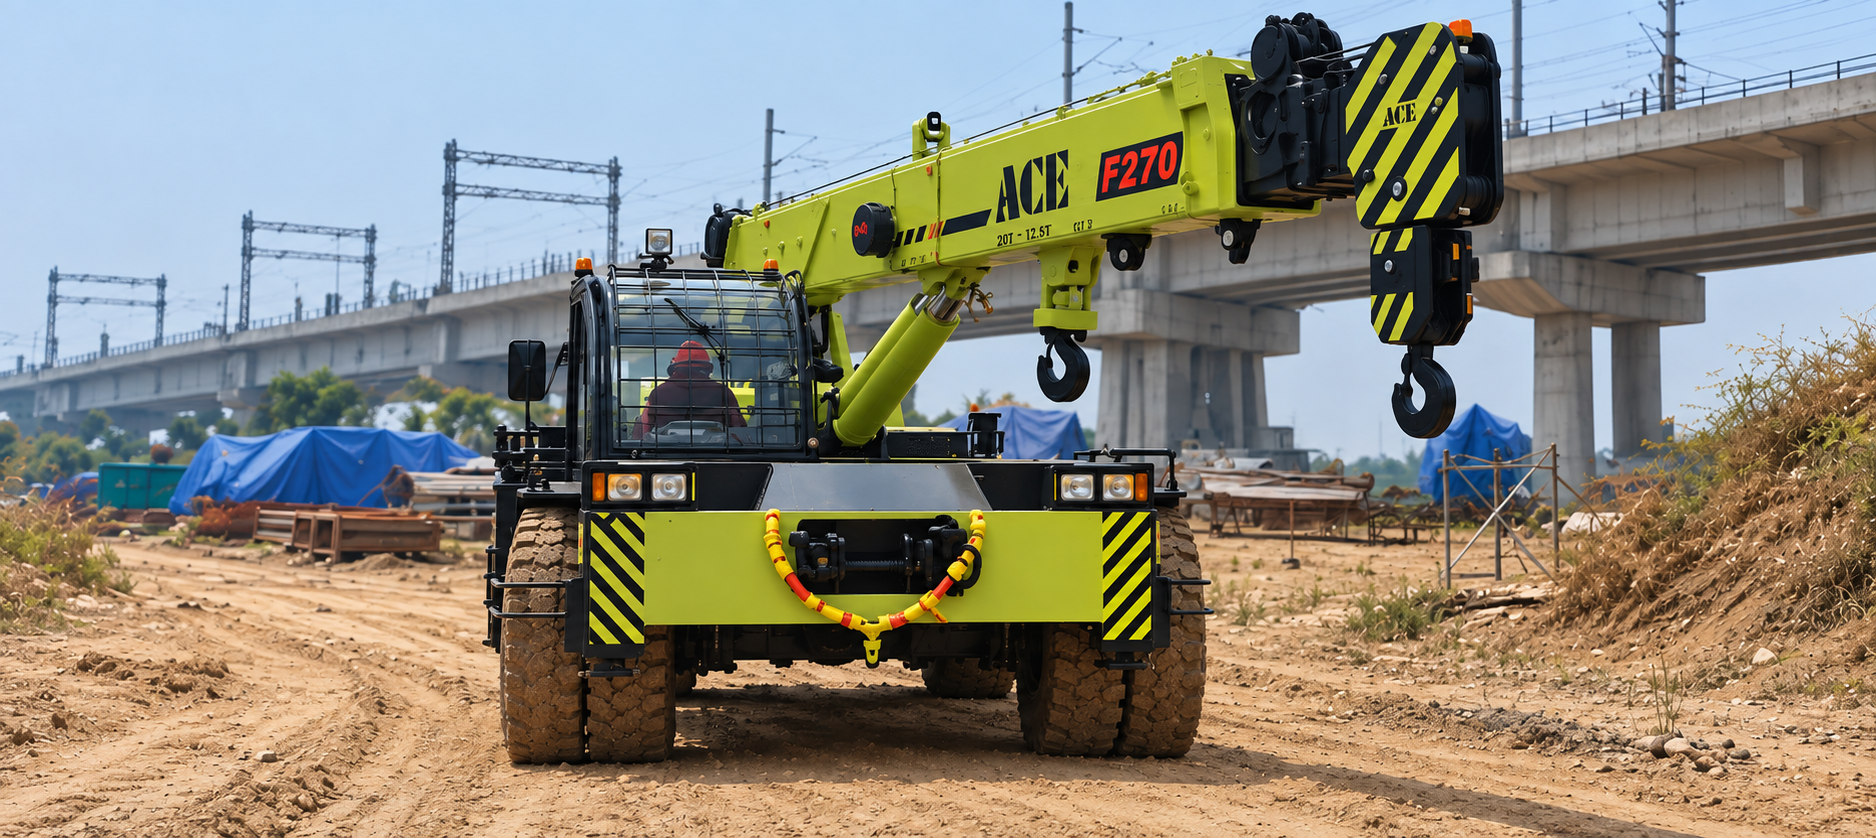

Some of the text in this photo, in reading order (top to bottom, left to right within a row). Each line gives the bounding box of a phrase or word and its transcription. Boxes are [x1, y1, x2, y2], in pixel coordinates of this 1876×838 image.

[1383, 103, 1416, 127] ACE
[996, 149, 1069, 223] ACE
[1102, 141, 1178, 193] F270
[997, 232, 1014, 247] 20T
[1026, 225, 1052, 241] 12.5T
